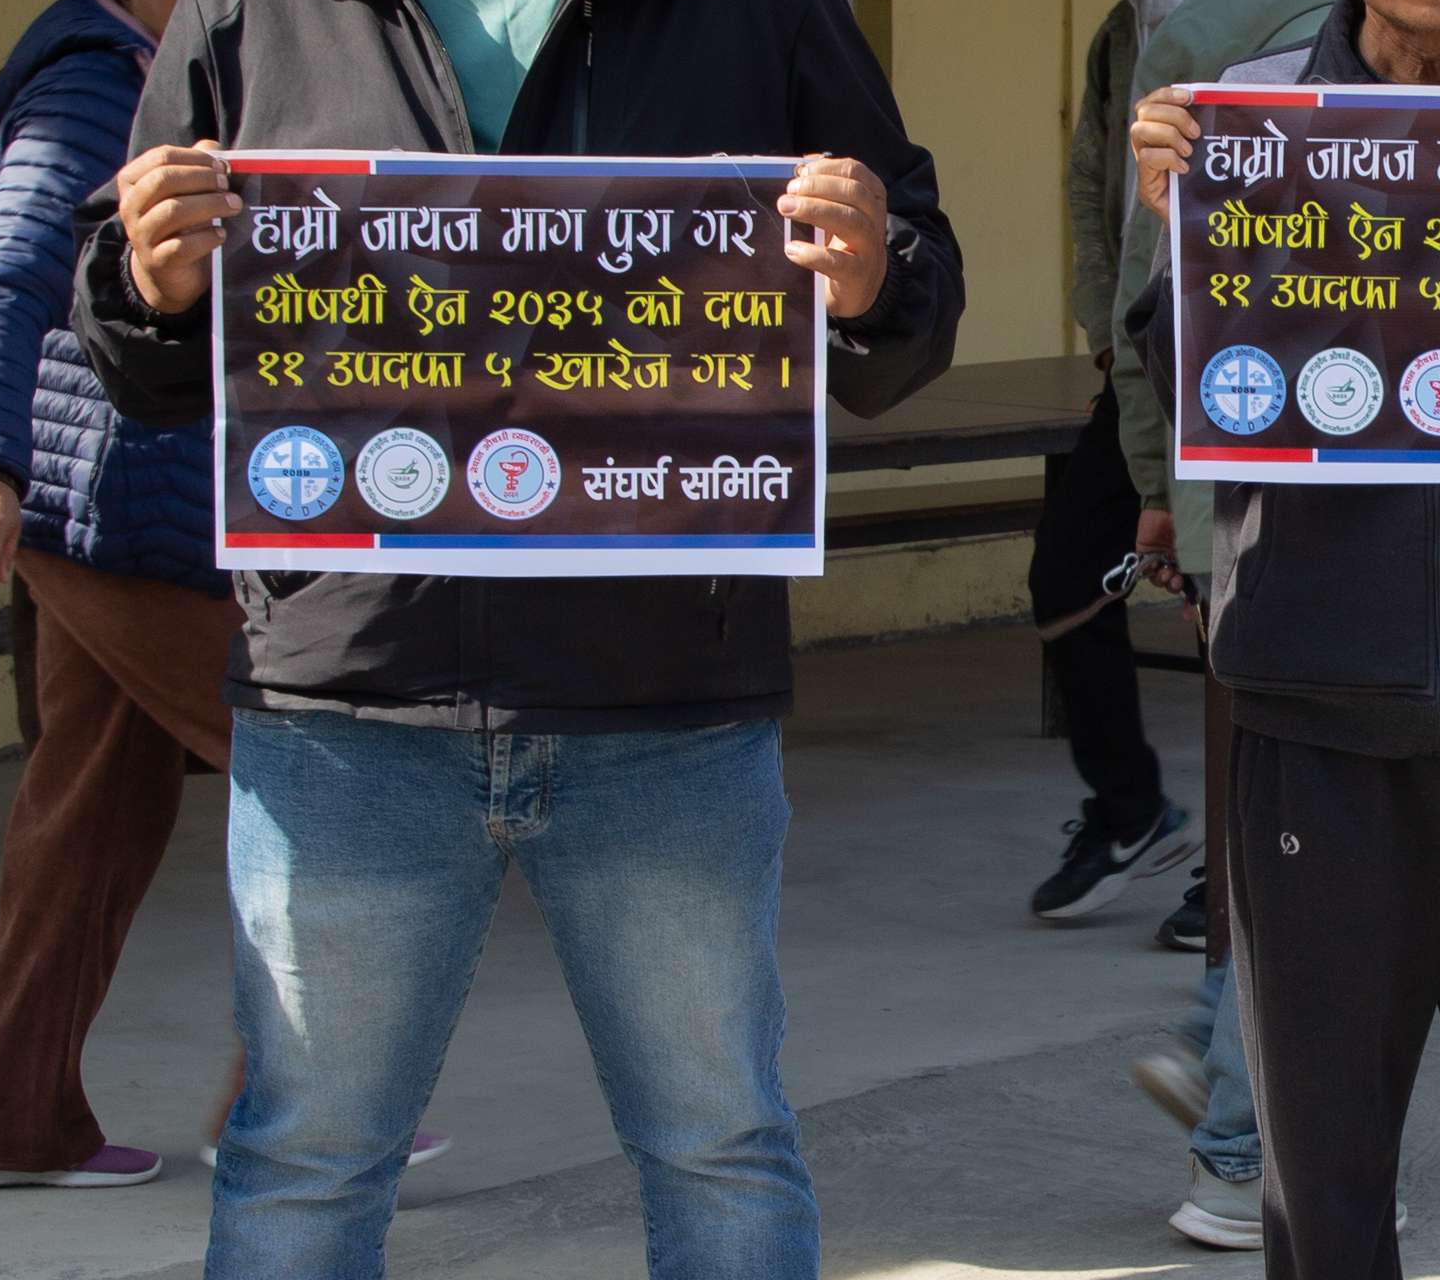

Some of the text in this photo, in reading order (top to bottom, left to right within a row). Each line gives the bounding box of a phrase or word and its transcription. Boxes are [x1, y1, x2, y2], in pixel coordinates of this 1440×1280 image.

[1203, 118, 1289, 187] हाम्रो
[1305, 137, 1419, 181] जायज
[249, 187, 342, 260] हाम्रो
[359, 205, 482, 252] जायज
[500, 207, 587, 252] माग
[597, 208, 675, 274] पुरा
[692, 209, 757, 257] गर
[1207, 200, 1329, 249] औषधी
[1348, 201, 1404, 261] ऐन
[255, 272, 784, 336] औषधी ऐन २०३५ को दफा
[1209, 273, 1252, 308] ११
[1271, 274, 1399, 312] उपदफा
[257, 351, 305, 386] ११
[327, 351, 465, 391] उपदफा
[534, 337, 671, 391] खारेज
[691, 353, 753, 390] गर
[581, 454, 793, 502] संघर्ष समिति
